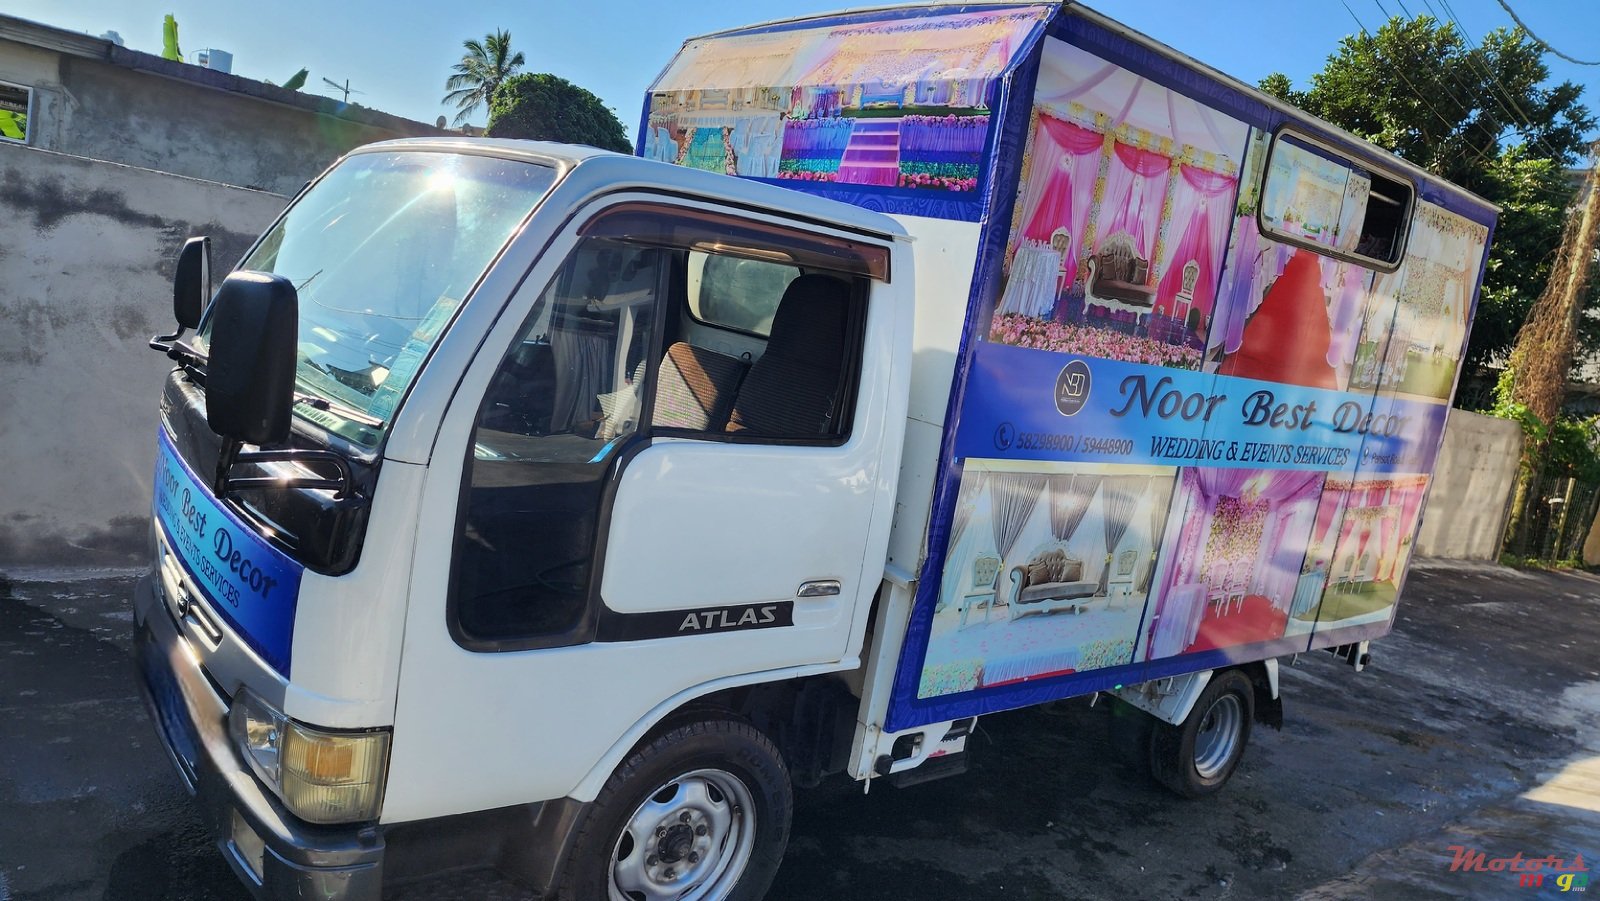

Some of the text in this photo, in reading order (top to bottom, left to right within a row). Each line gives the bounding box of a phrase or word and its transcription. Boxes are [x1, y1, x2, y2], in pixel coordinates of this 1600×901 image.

[1109, 374, 1413, 438] Noor Best Decor
[1150, 436, 1350, 466] WEDDING & EVENTS SERVICES
[180, 528, 201, 566] EVENTS
[201, 556, 240, 608] SERVICES
[182, 488, 207, 538] Best
[214, 528, 278, 599] Decor
[679, 606, 777, 631] ATLAS
